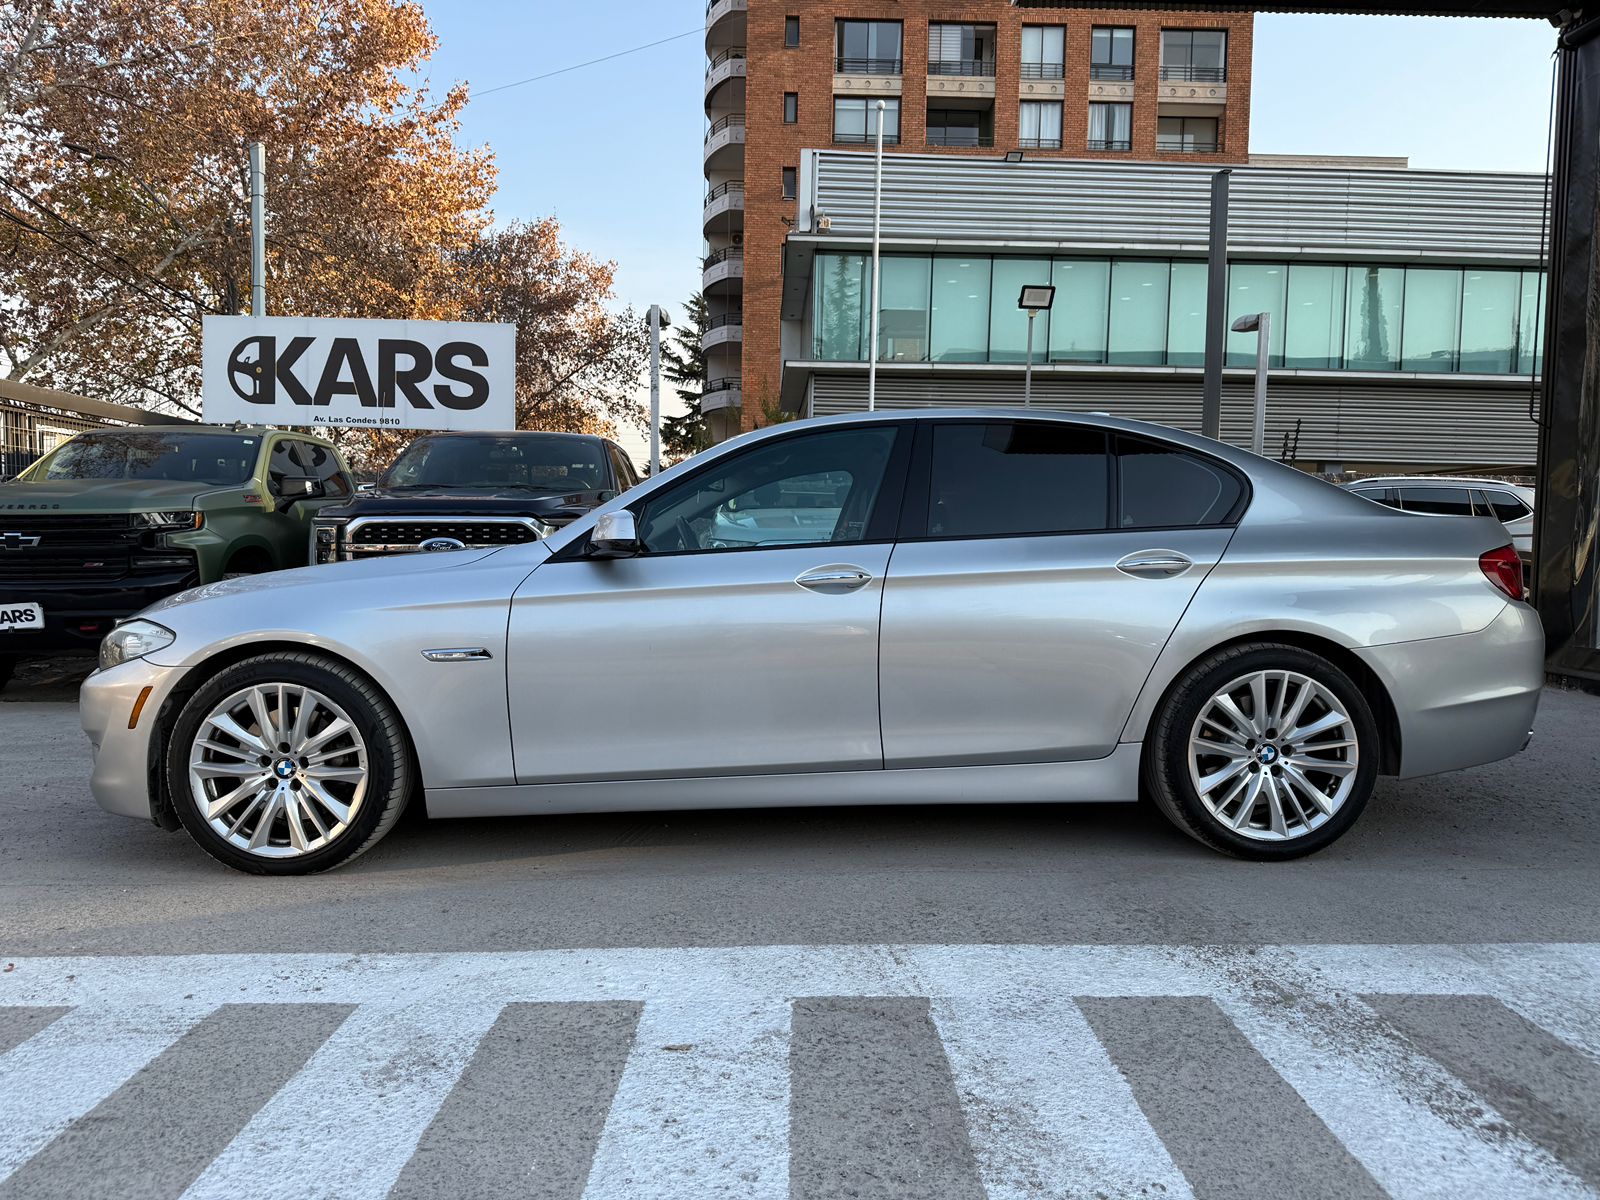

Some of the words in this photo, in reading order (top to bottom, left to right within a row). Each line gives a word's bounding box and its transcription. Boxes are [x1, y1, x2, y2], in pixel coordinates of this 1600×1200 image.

[257, 335, 491, 411] KARS
[313, 415, 326, 423] Av.
[345, 416, 377, 424] Condes
[379, 417, 400, 425] 9810
